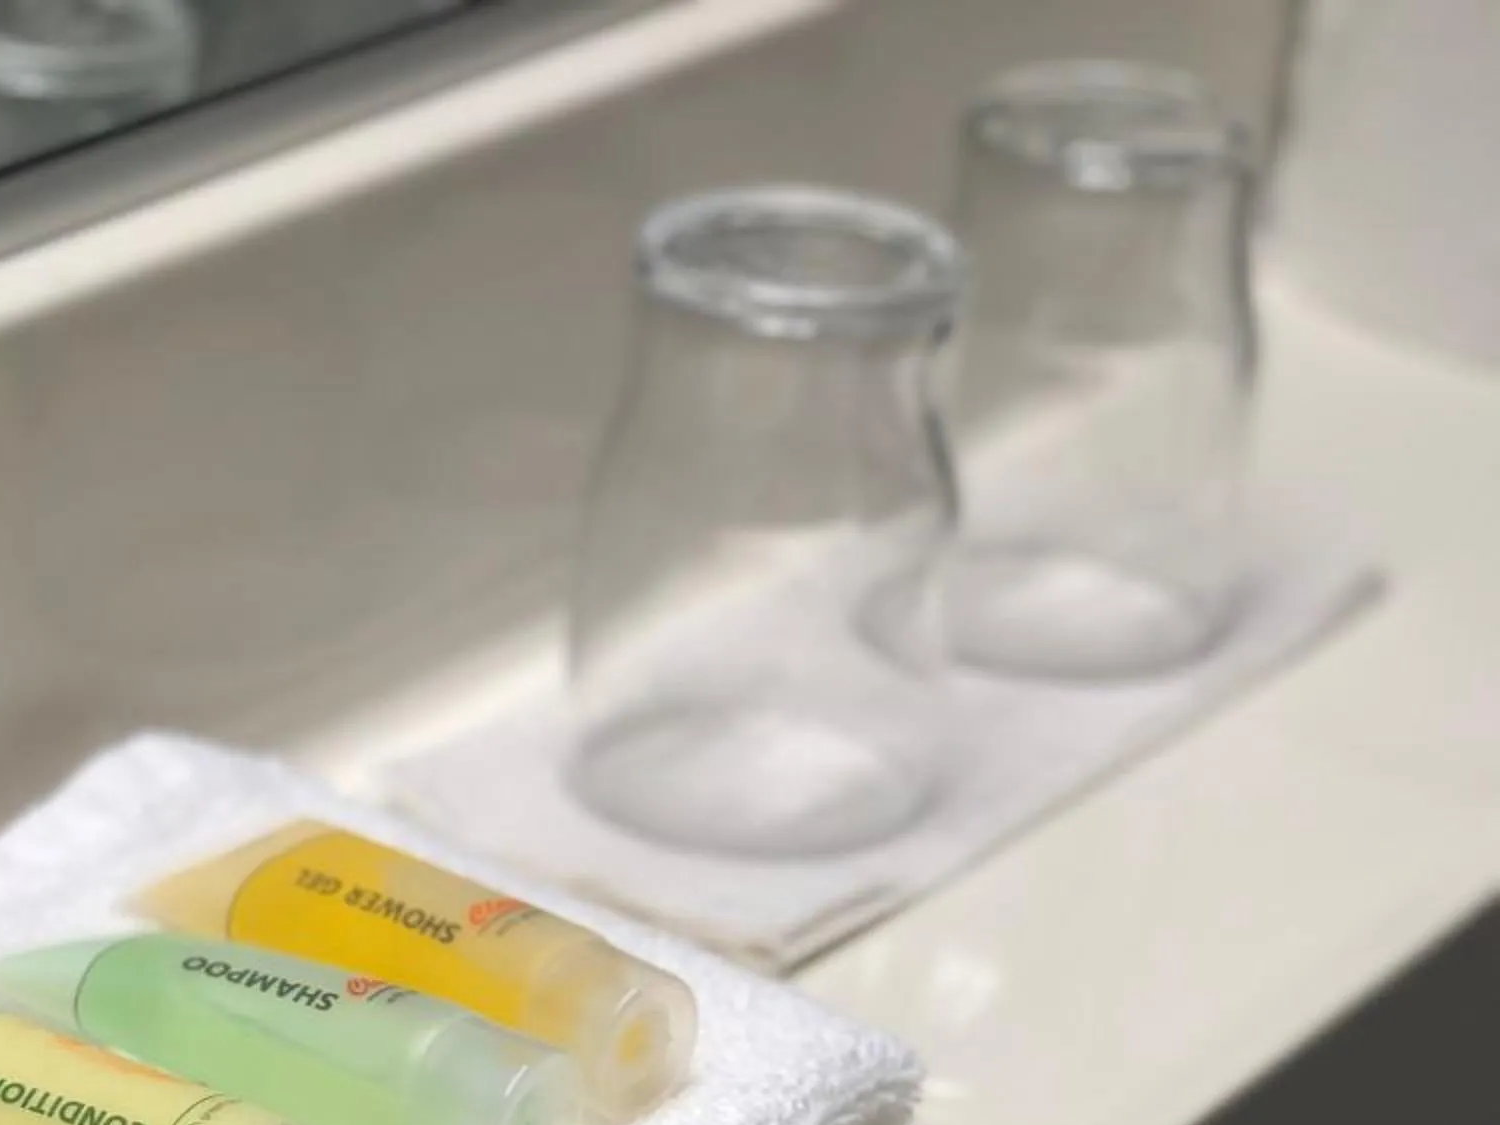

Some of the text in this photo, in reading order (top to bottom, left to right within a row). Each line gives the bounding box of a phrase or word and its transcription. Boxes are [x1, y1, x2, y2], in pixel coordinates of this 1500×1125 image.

[295, 867, 343, 896] GEL
[343, 885, 461, 944] SHOWER
[182, 956, 339, 1011] SHAMPOO
